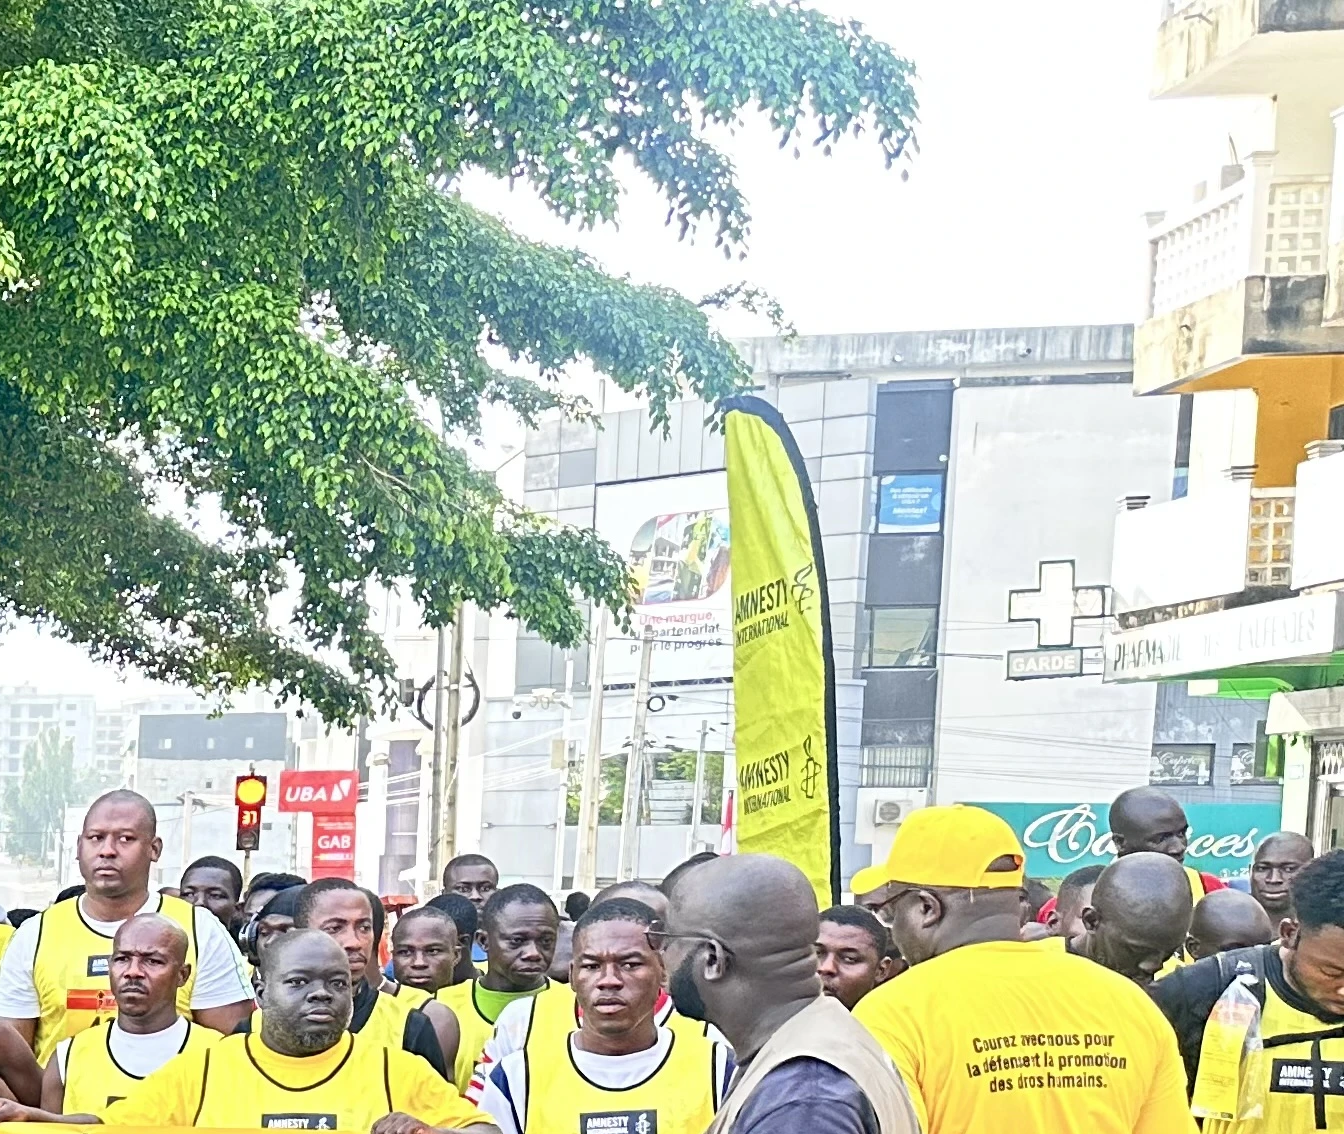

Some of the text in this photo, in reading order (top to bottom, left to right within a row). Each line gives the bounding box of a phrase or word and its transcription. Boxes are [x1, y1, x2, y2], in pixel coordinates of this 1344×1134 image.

[734, 577, 789, 626] AMNESTY
[1012, 655, 1076, 673] GARDE
[739, 749, 790, 793] AMNESTY
[285, 786, 327, 802] UBA
[318, 835, 351, 849] GAB
[1024, 803, 1259, 864] Caices
[972, 1034, 1018, 1054] Courez
[1048, 1033, 1081, 1047] nous
[1084, 1033, 1116, 1049] pour
[966, 1062, 982, 1079] la
[1044, 1051, 1055, 1067] la
[989, 1071, 1108, 1093] des humains.
[268, 1118, 310, 1129] AMNESTY
[587, 1115, 630, 1128] AMNESTY
